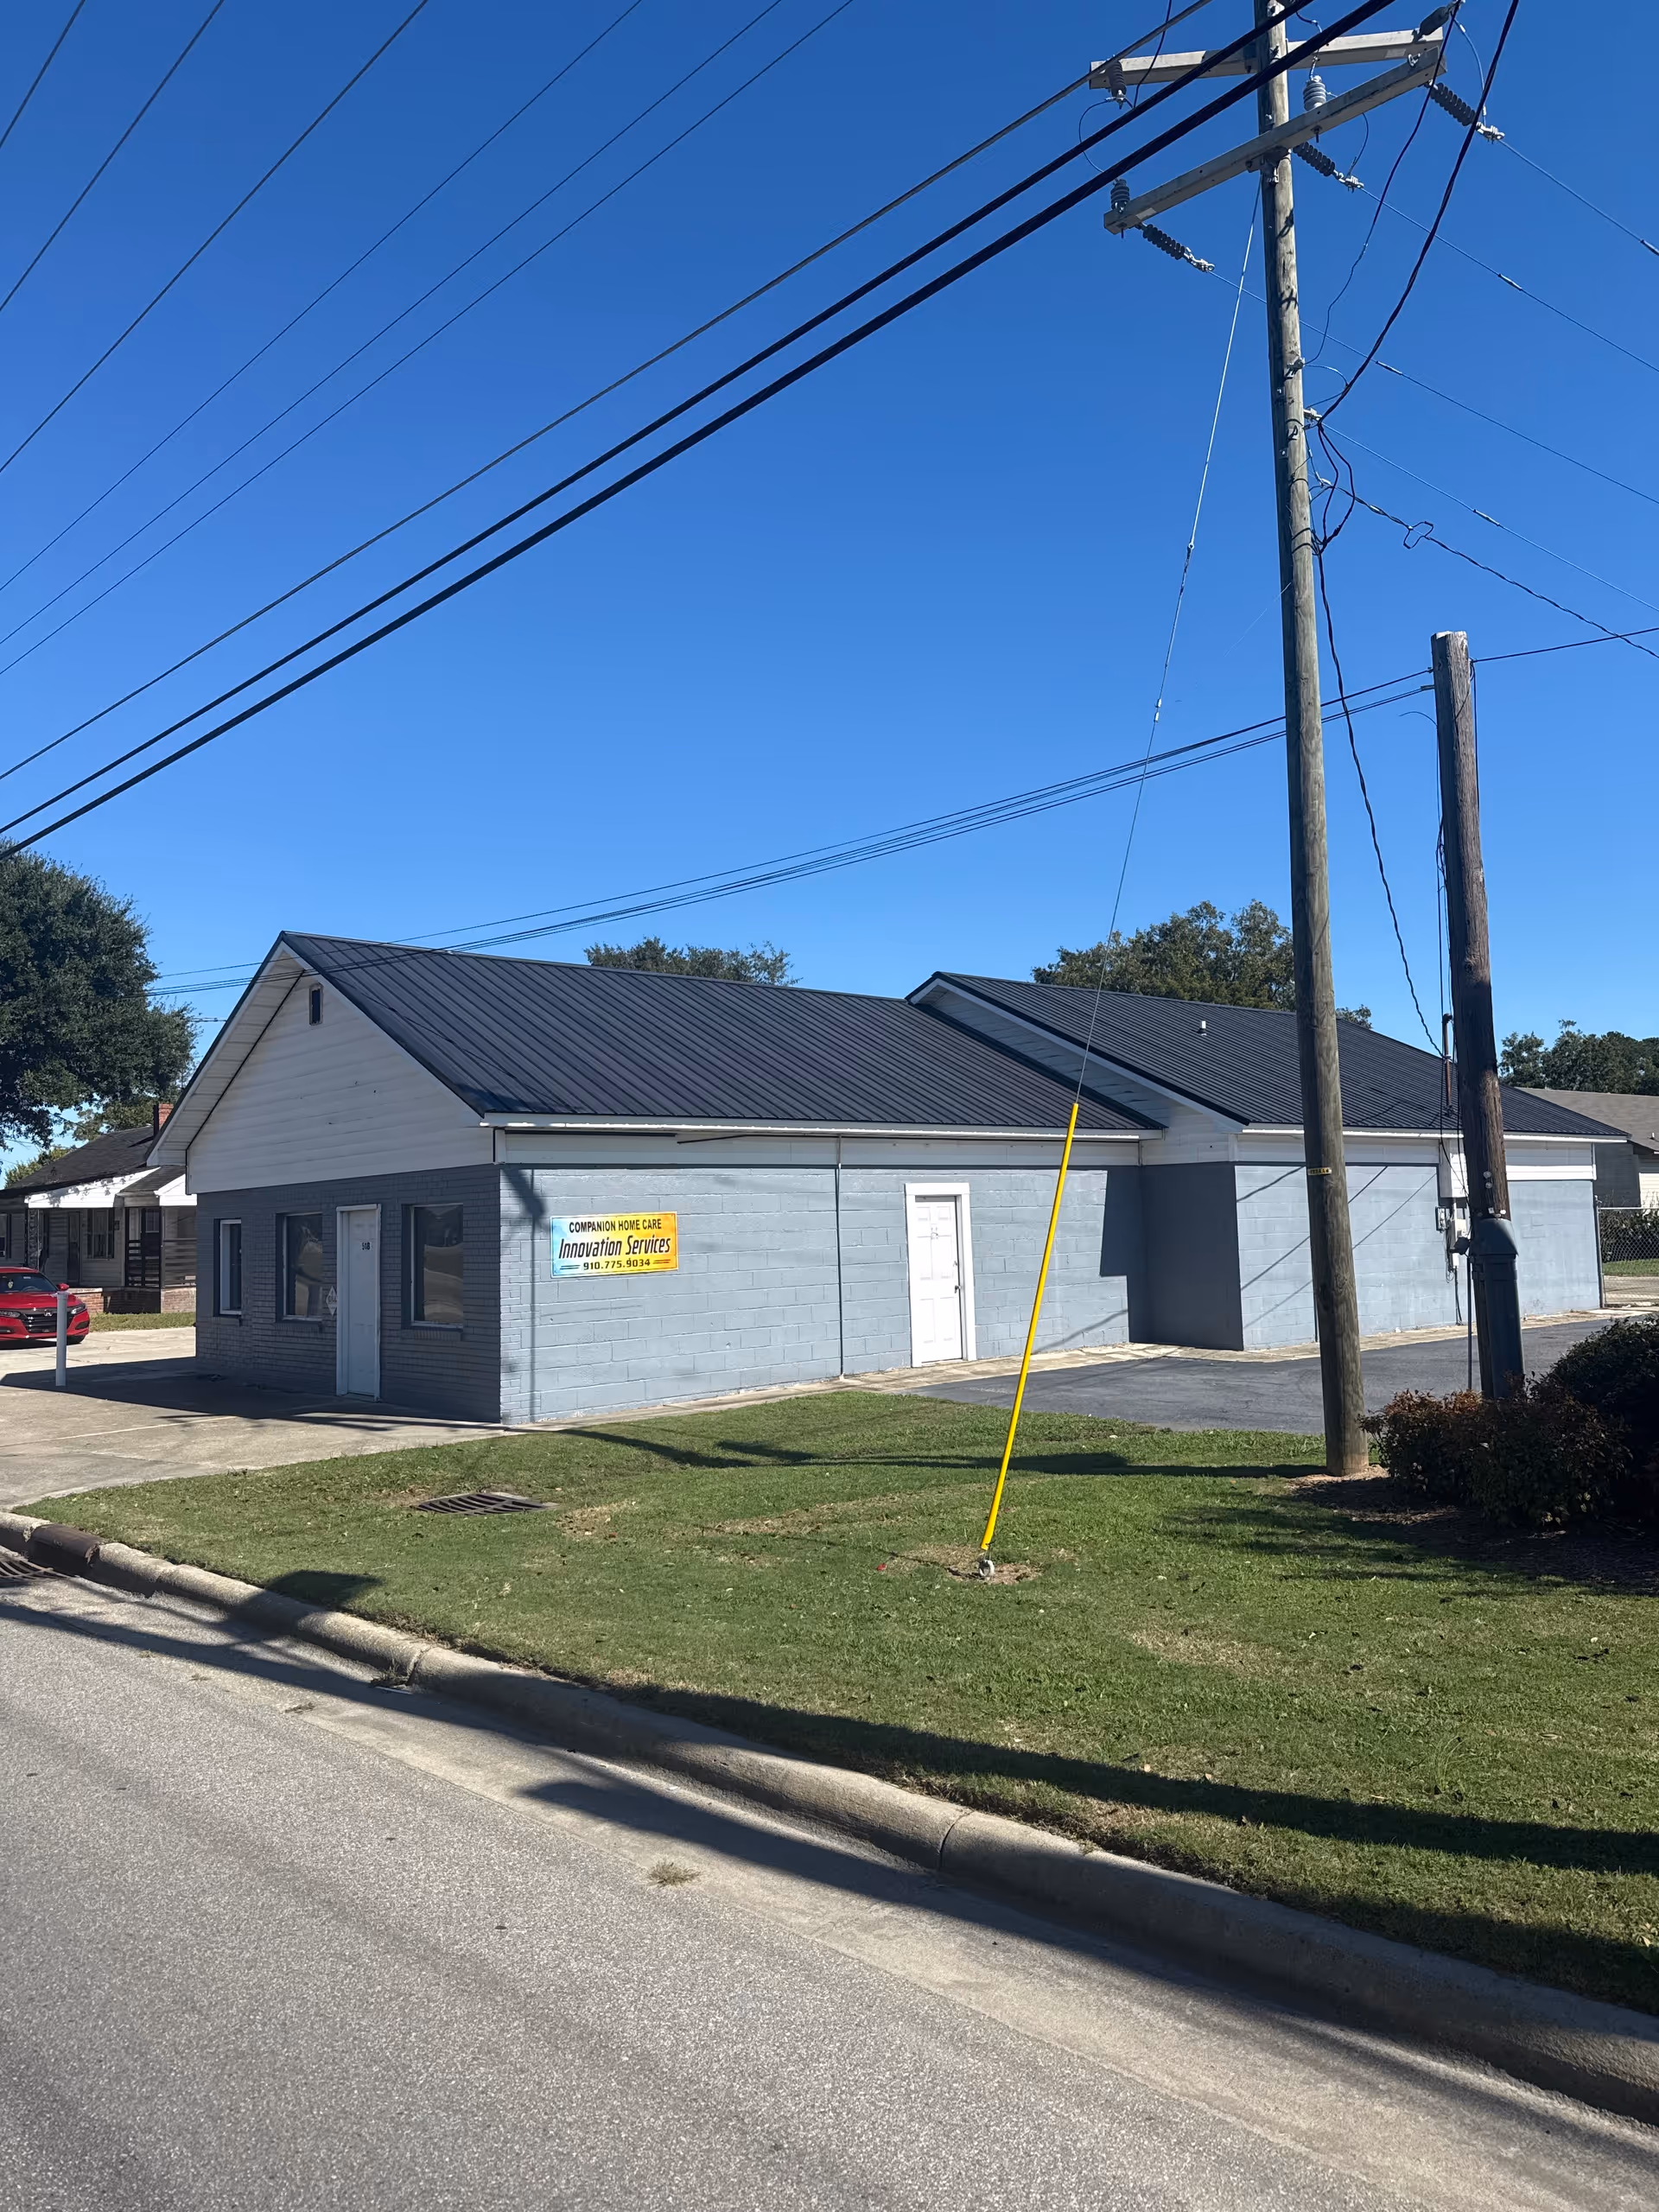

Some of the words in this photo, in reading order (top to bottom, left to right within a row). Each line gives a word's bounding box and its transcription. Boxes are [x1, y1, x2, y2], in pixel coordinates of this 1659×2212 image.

[569, 1220, 616, 1233] COMPANION
[618, 1219, 640, 1230] HOME
[642, 1218, 662, 1230] CARE
[558, 1236, 622, 1259] Innovation
[625, 1235, 671, 1255] Services
[583, 1259, 651, 1270] 910.775.9034
